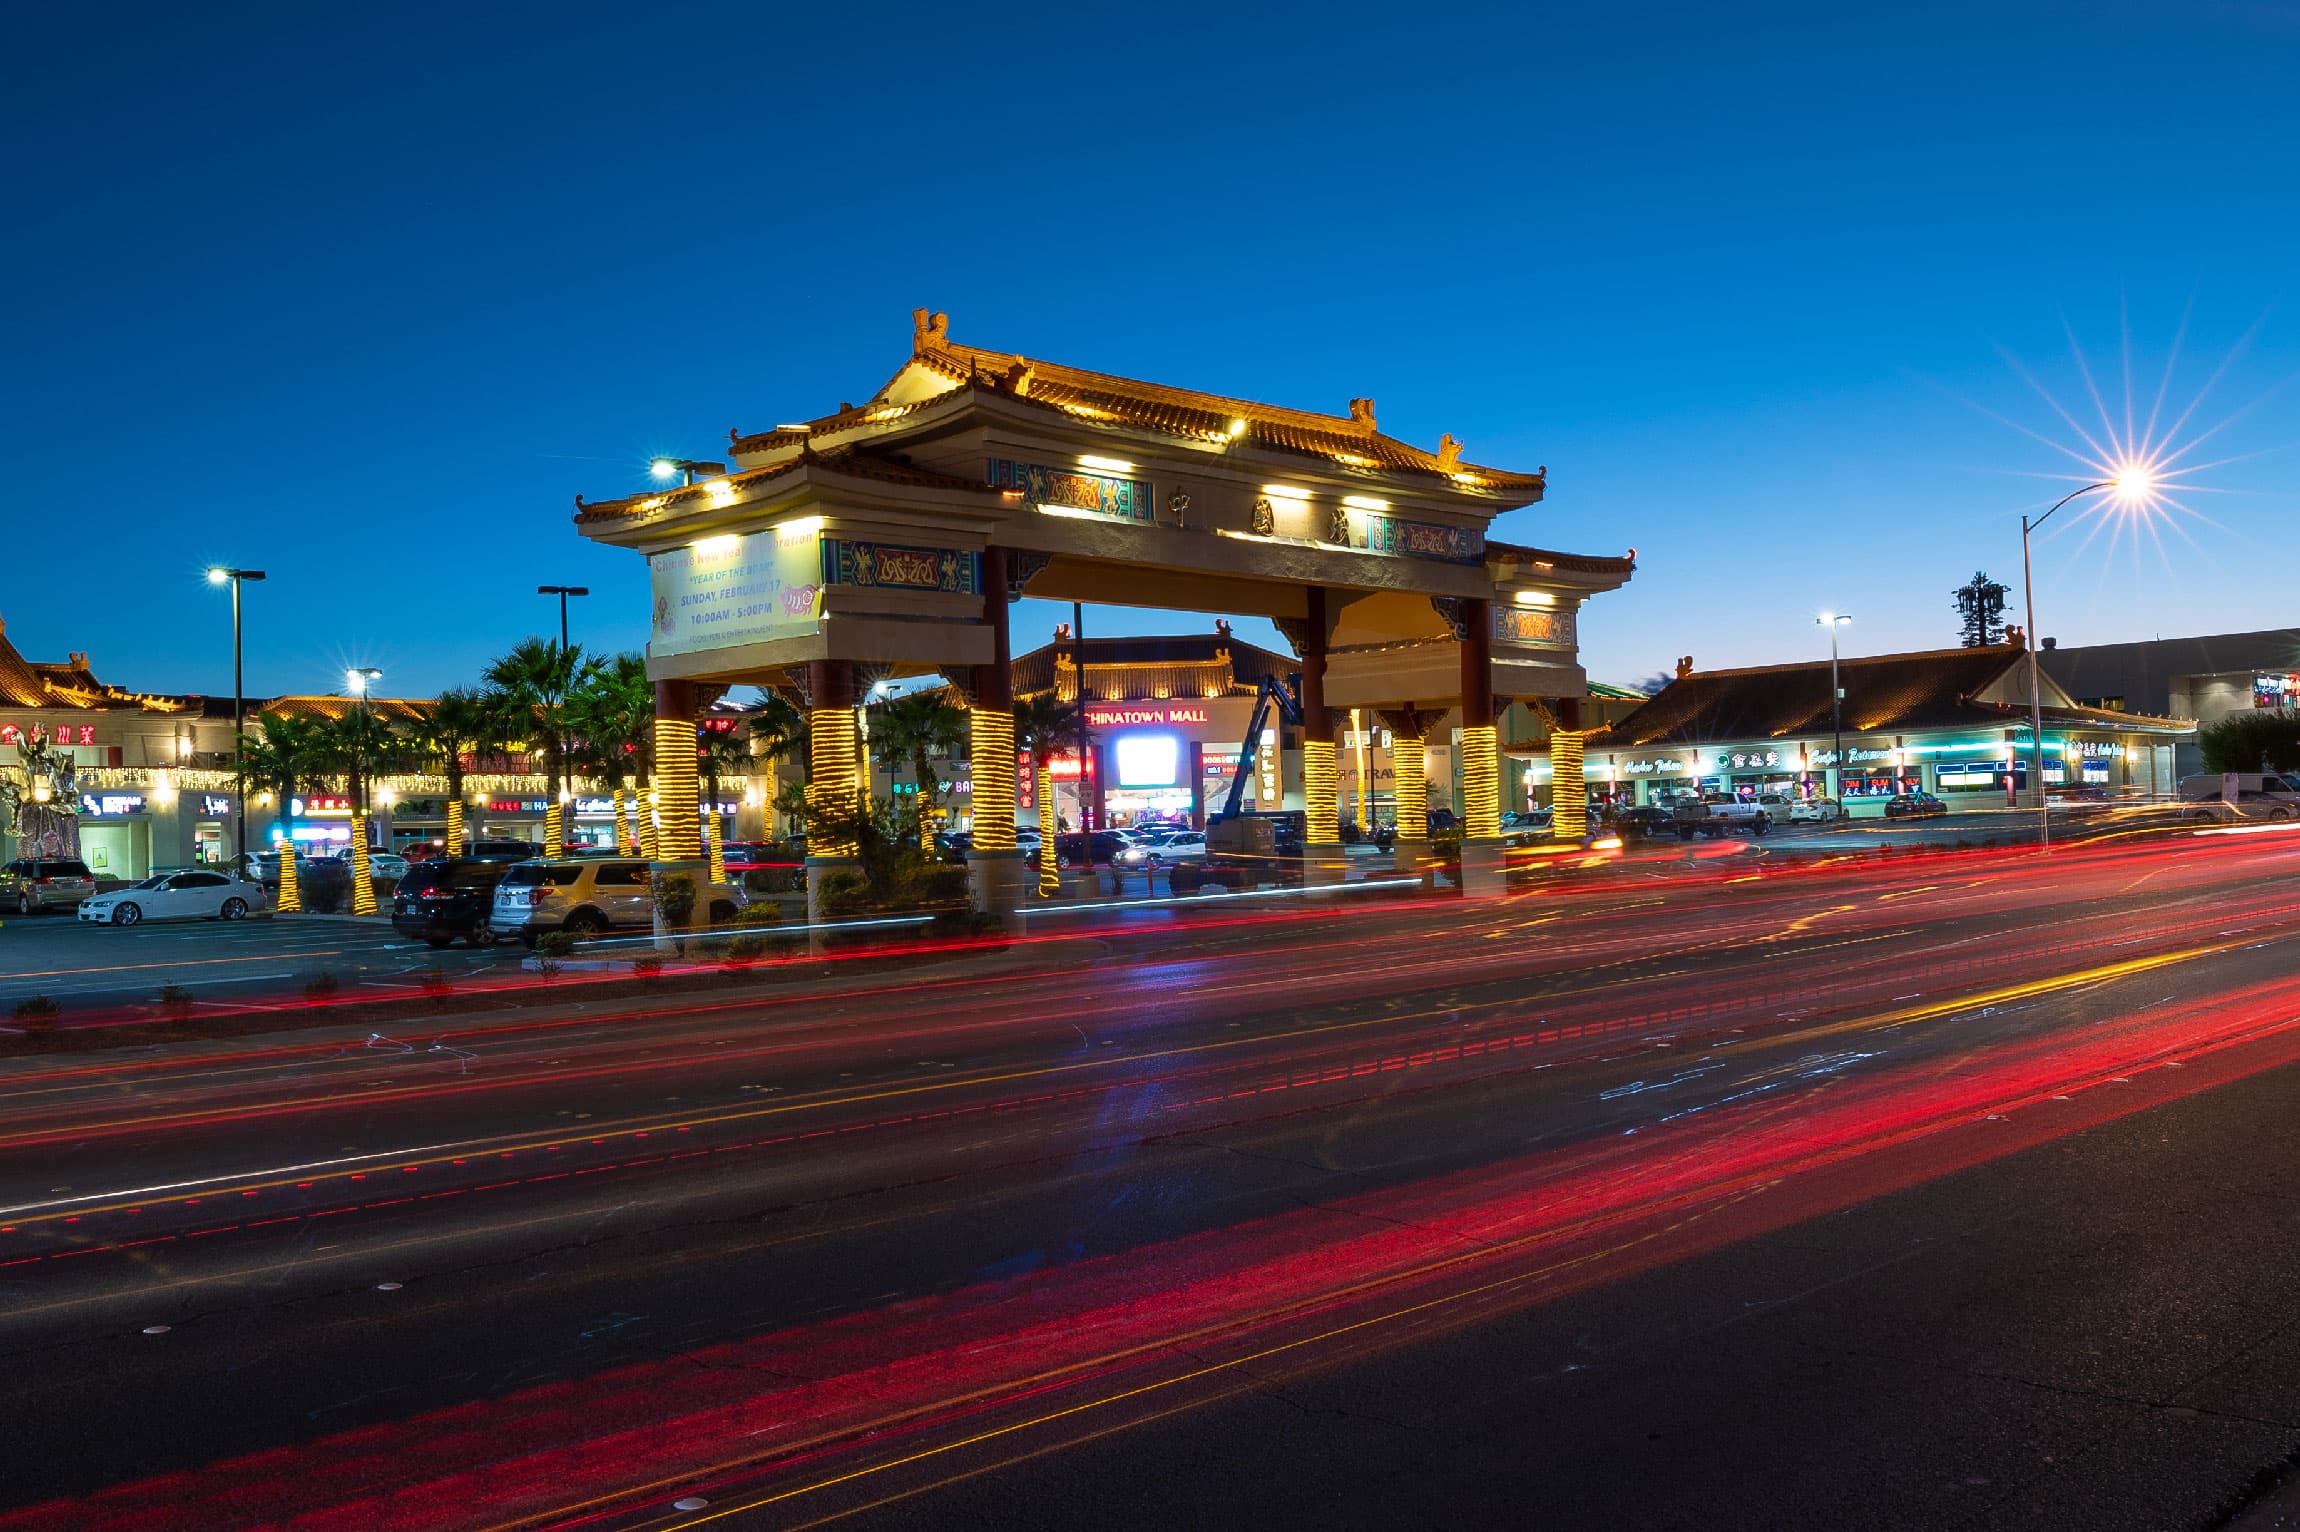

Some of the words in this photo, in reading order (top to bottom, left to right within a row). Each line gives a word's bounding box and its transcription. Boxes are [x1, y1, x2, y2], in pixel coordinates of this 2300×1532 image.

[715, 570, 726, 580] OF
[729, 566, 744, 578] THE
[719, 583, 768, 599] FEBRUARY
[770, 579, 781, 593] 17
[691, 609, 729, 625] 10:00AM
[737, 603, 773, 619] 5:00PM
[1169, 710, 1207, 722] MALL
[1871, 778, 1889, 787] SUM
